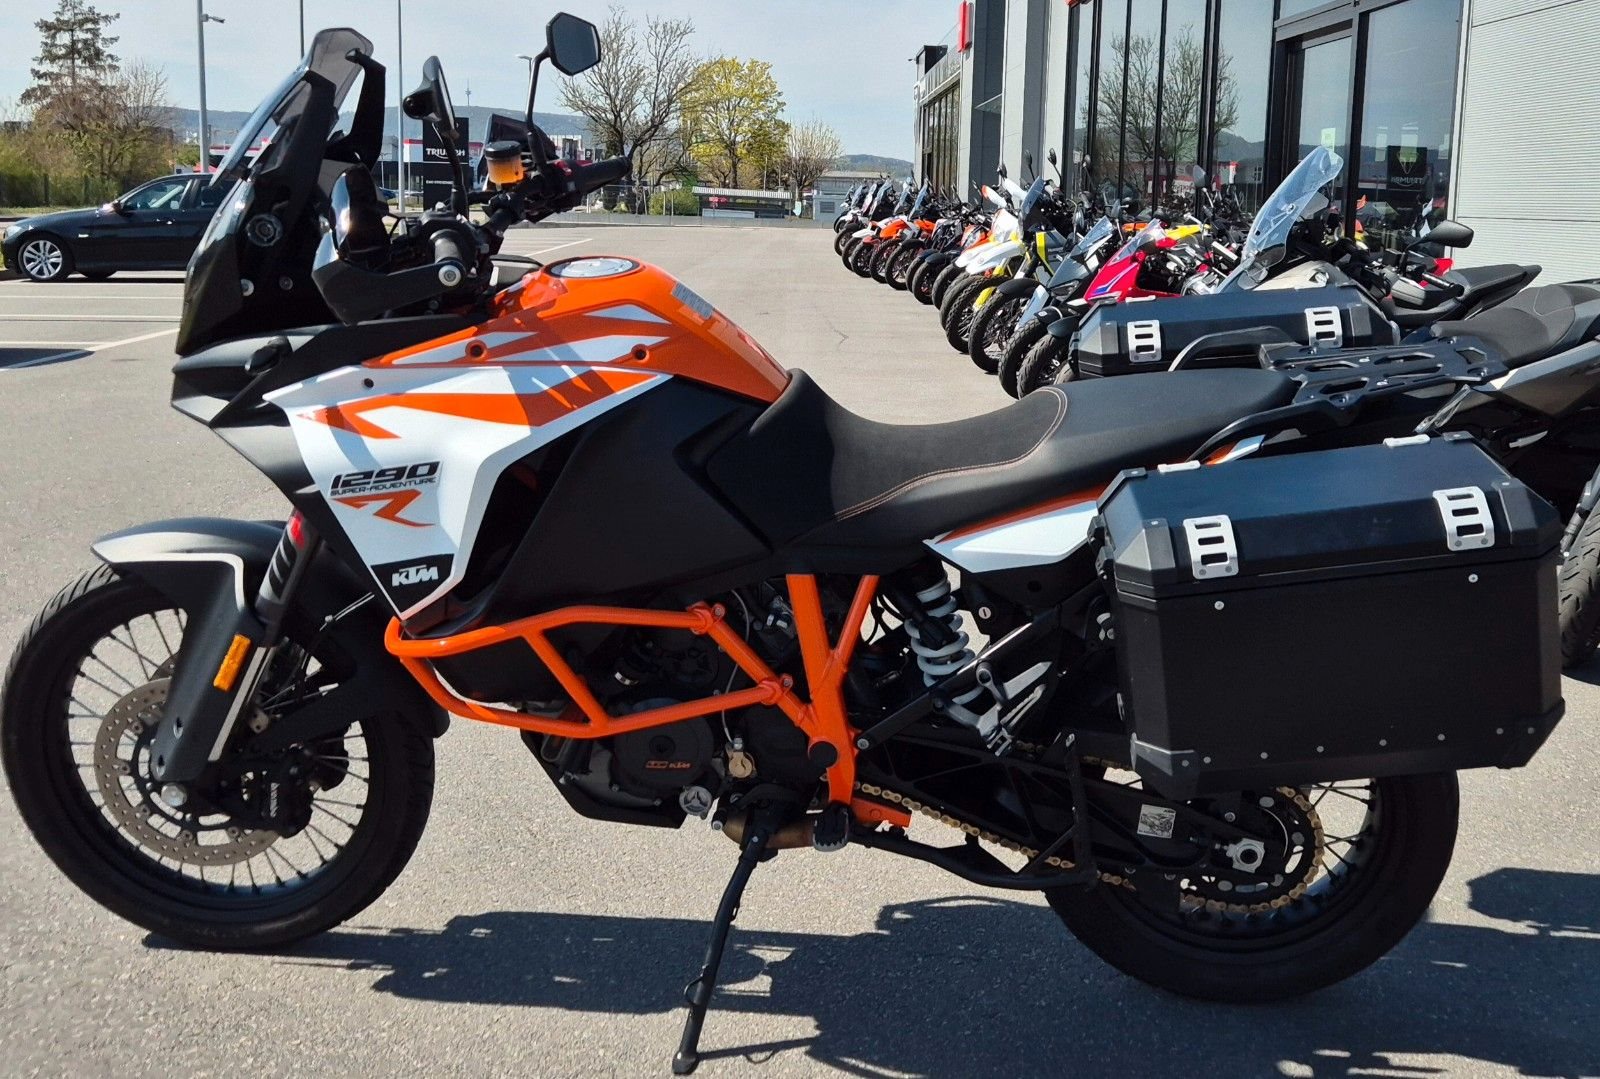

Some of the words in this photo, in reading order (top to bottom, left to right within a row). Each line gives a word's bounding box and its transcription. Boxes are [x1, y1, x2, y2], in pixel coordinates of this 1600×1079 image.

[425, 148, 466, 158] TRIUH
[330, 461, 441, 490] 1290
[330, 477, 438, 497] SUPER-ADVENTURE
[391, 564, 439, 587] KTM
